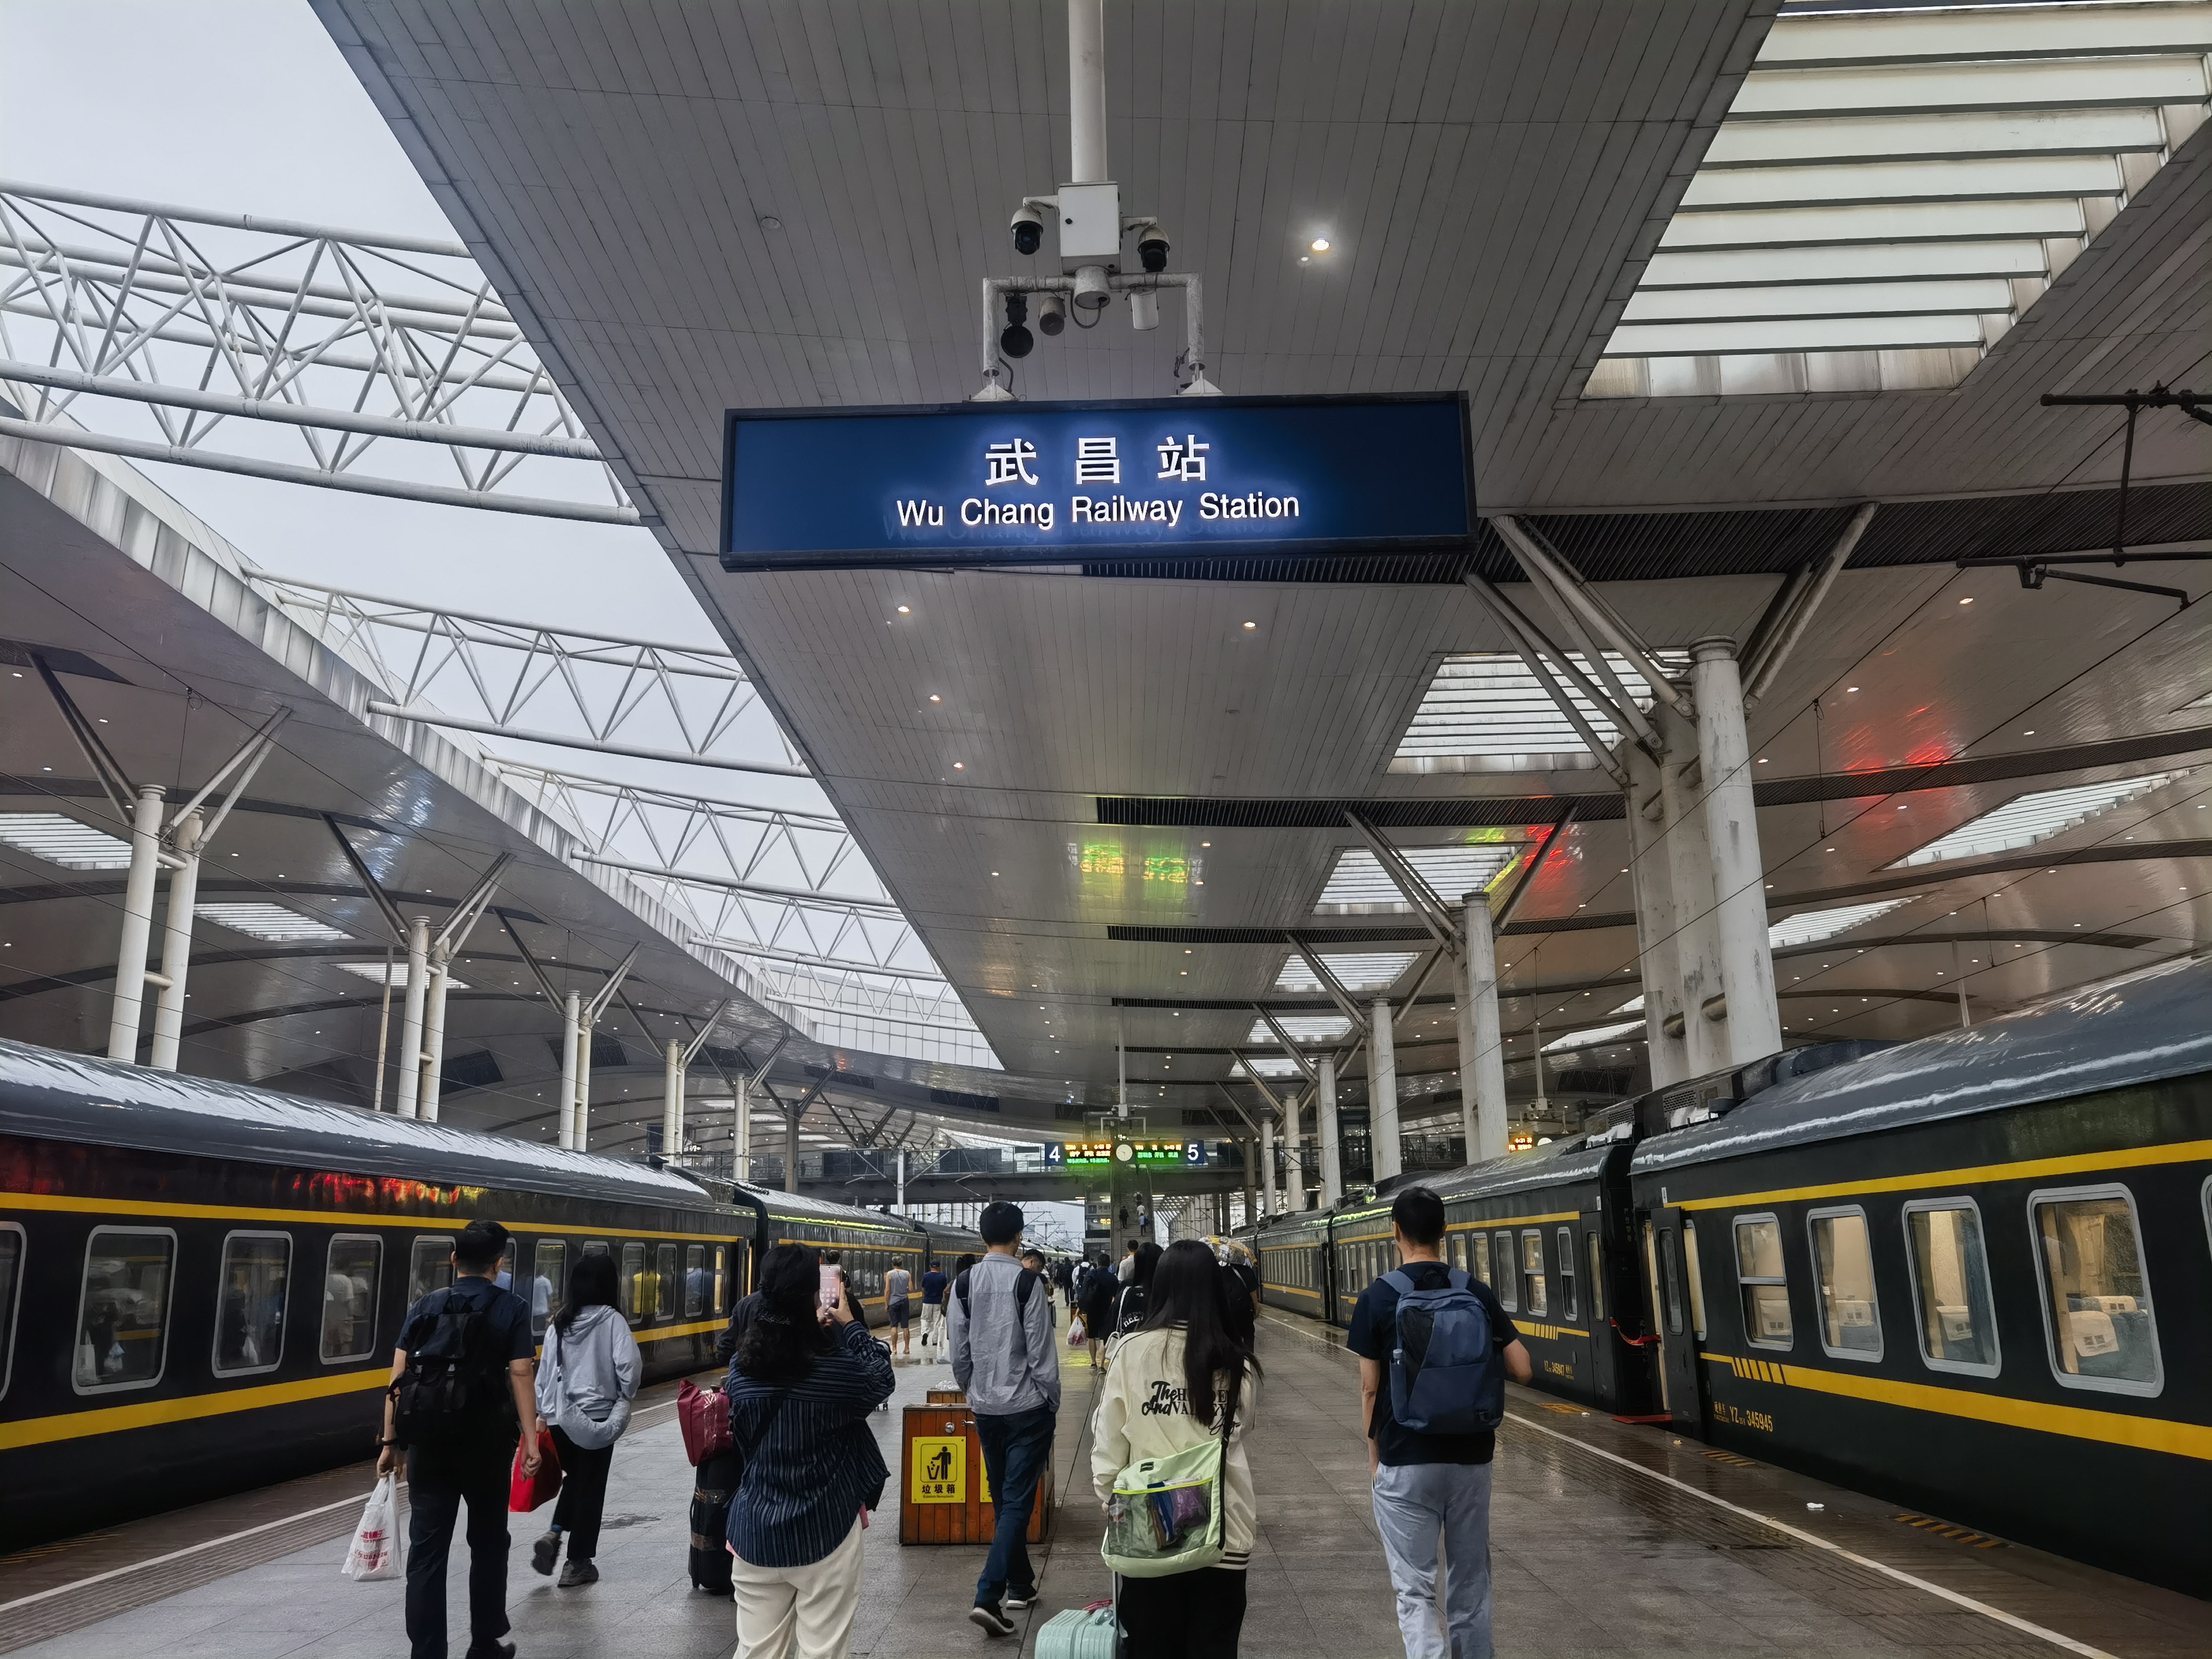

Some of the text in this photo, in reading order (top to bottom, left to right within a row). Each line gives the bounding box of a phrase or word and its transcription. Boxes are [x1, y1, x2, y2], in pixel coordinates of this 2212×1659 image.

[984, 435, 1210, 485] 武昌站
[896, 491, 1300, 531] Wu Chang Railway Station
[1049, 1145, 1061, 1162] 4
[1187, 1144, 1199, 1161] 5
[1151, 1380, 1178, 1401] The
[1141, 1393, 1172, 1416] And
[1746, 1410, 1773, 1432] 345945
[922, 1484, 955, 1494] 垃圾箱
